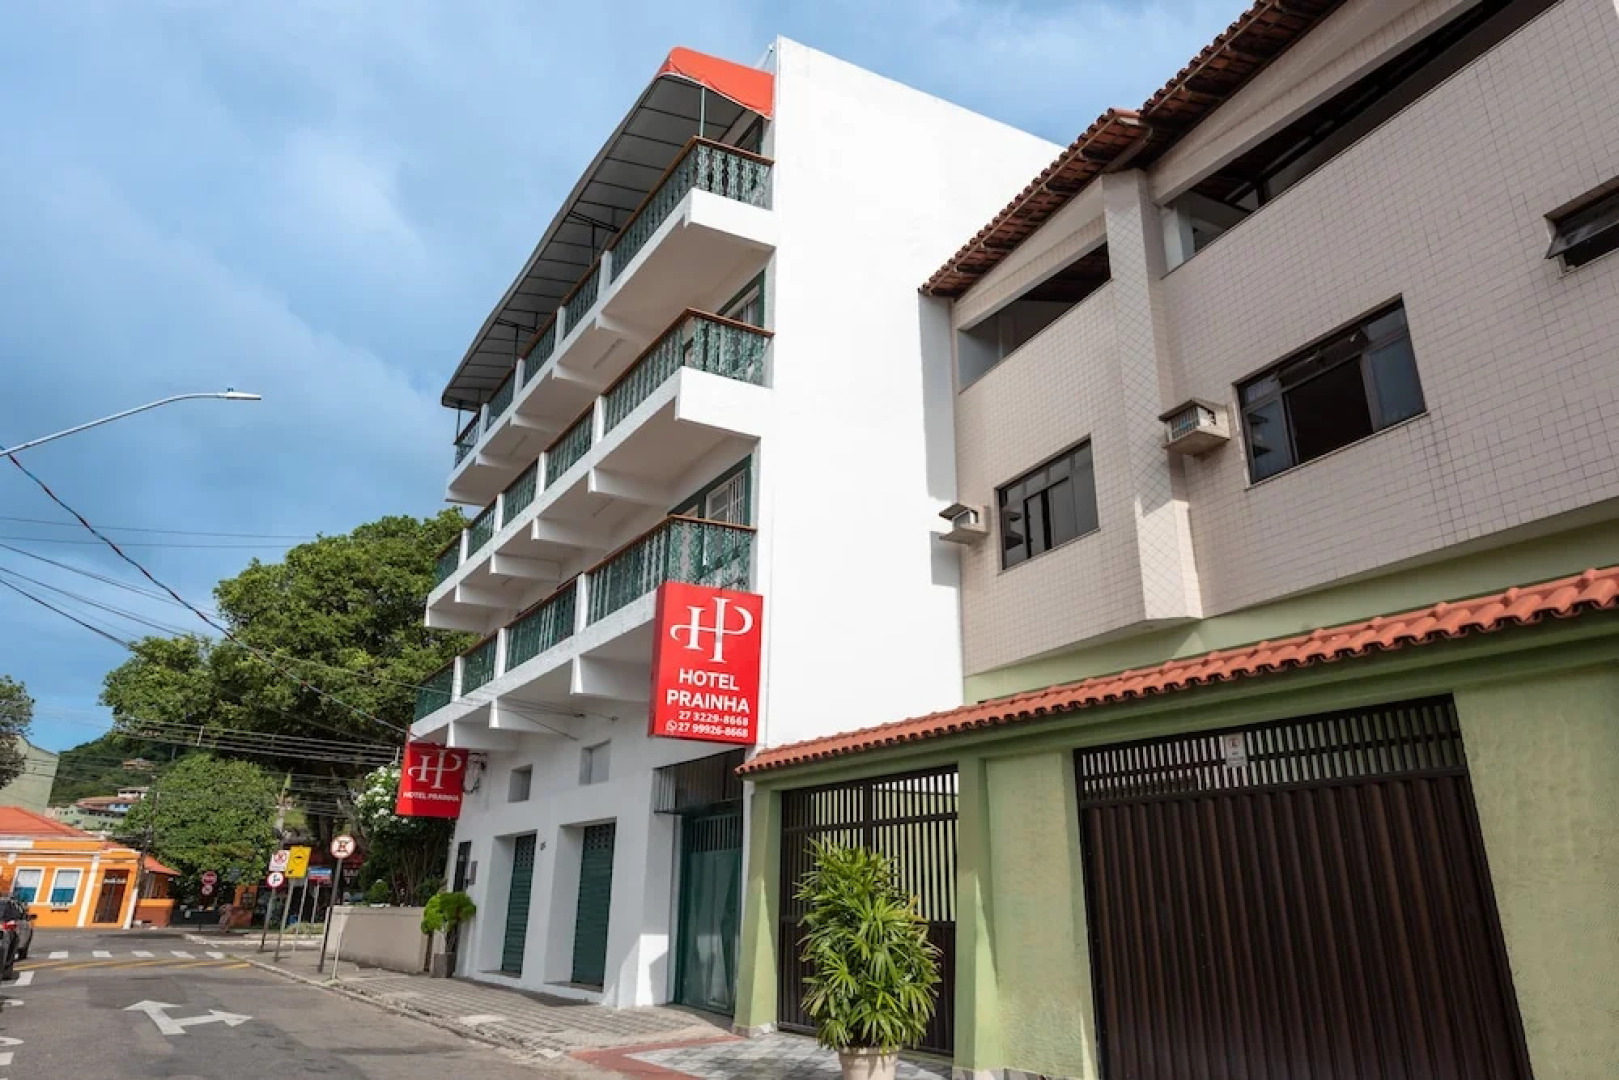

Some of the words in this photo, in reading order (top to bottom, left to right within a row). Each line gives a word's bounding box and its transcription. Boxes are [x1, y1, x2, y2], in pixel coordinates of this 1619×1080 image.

[669, 596, 754, 664] HP
[679, 667, 739, 691] HOTEL
[666, 689, 750, 713] PRAINHA
[678, 710, 691, 720] 27
[678, 722, 691, 732] 27
